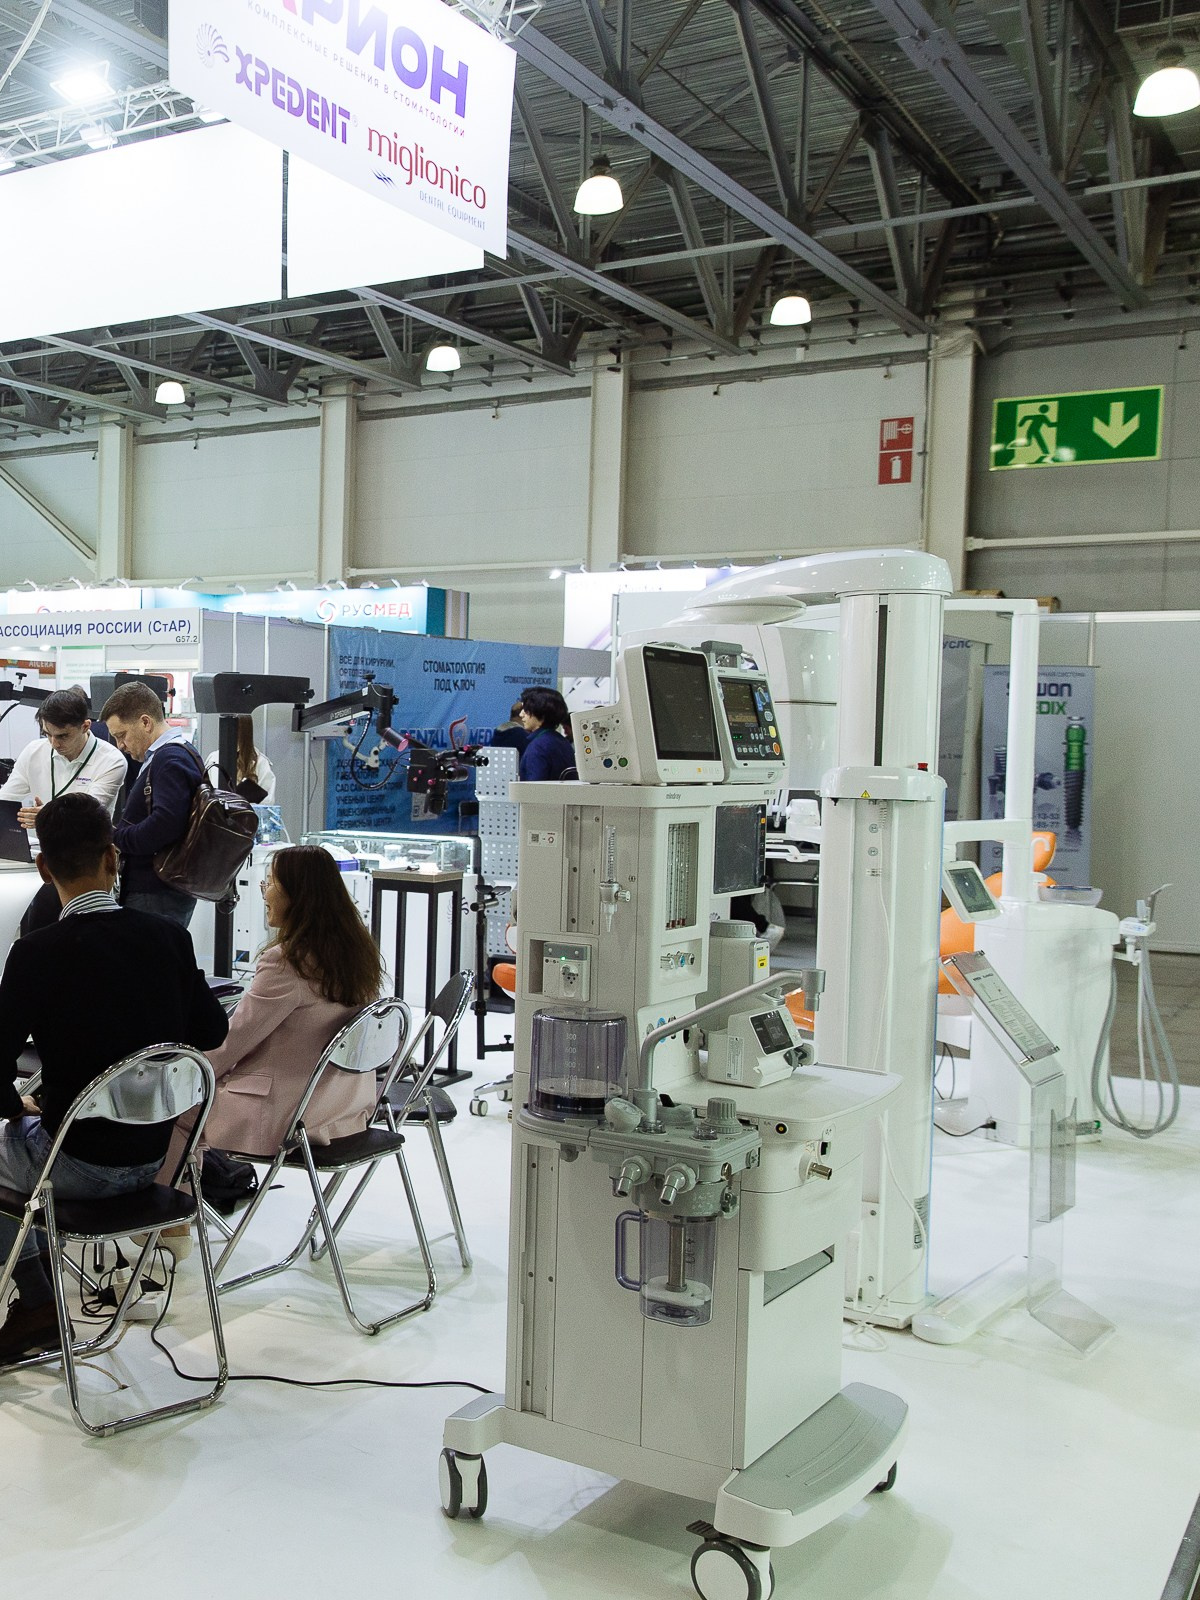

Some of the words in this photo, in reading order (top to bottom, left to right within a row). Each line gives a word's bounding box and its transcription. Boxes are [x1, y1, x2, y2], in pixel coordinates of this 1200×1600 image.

[247, 1, 329, 58] КОМПЛЕКСНЫЕ
[333, 52, 380, 89] РЕШЕНИЯ
[384, 83, 390, 95] В
[393, 90, 465, 138] СТОМАТОЛОГИИ
[235, 45, 351, 145] XPEDENT
[367, 126, 486, 210] miglionico
[419, 190, 445, 212] DENTAL
[448, 204, 486, 231] EQUIPMENT
[342, 603, 411, 620] РУСМЕД
[87, 620, 142, 636] РОССИИ
[148, 619, 191, 635] (СтАР)
[175, 635, 198, 643] G57.2
[423, 660, 486, 675] СТОМАТОЛОГИЯ
[434, 678, 452, 693] ПОД
[453, 679, 475, 691] КЛЮЧ
